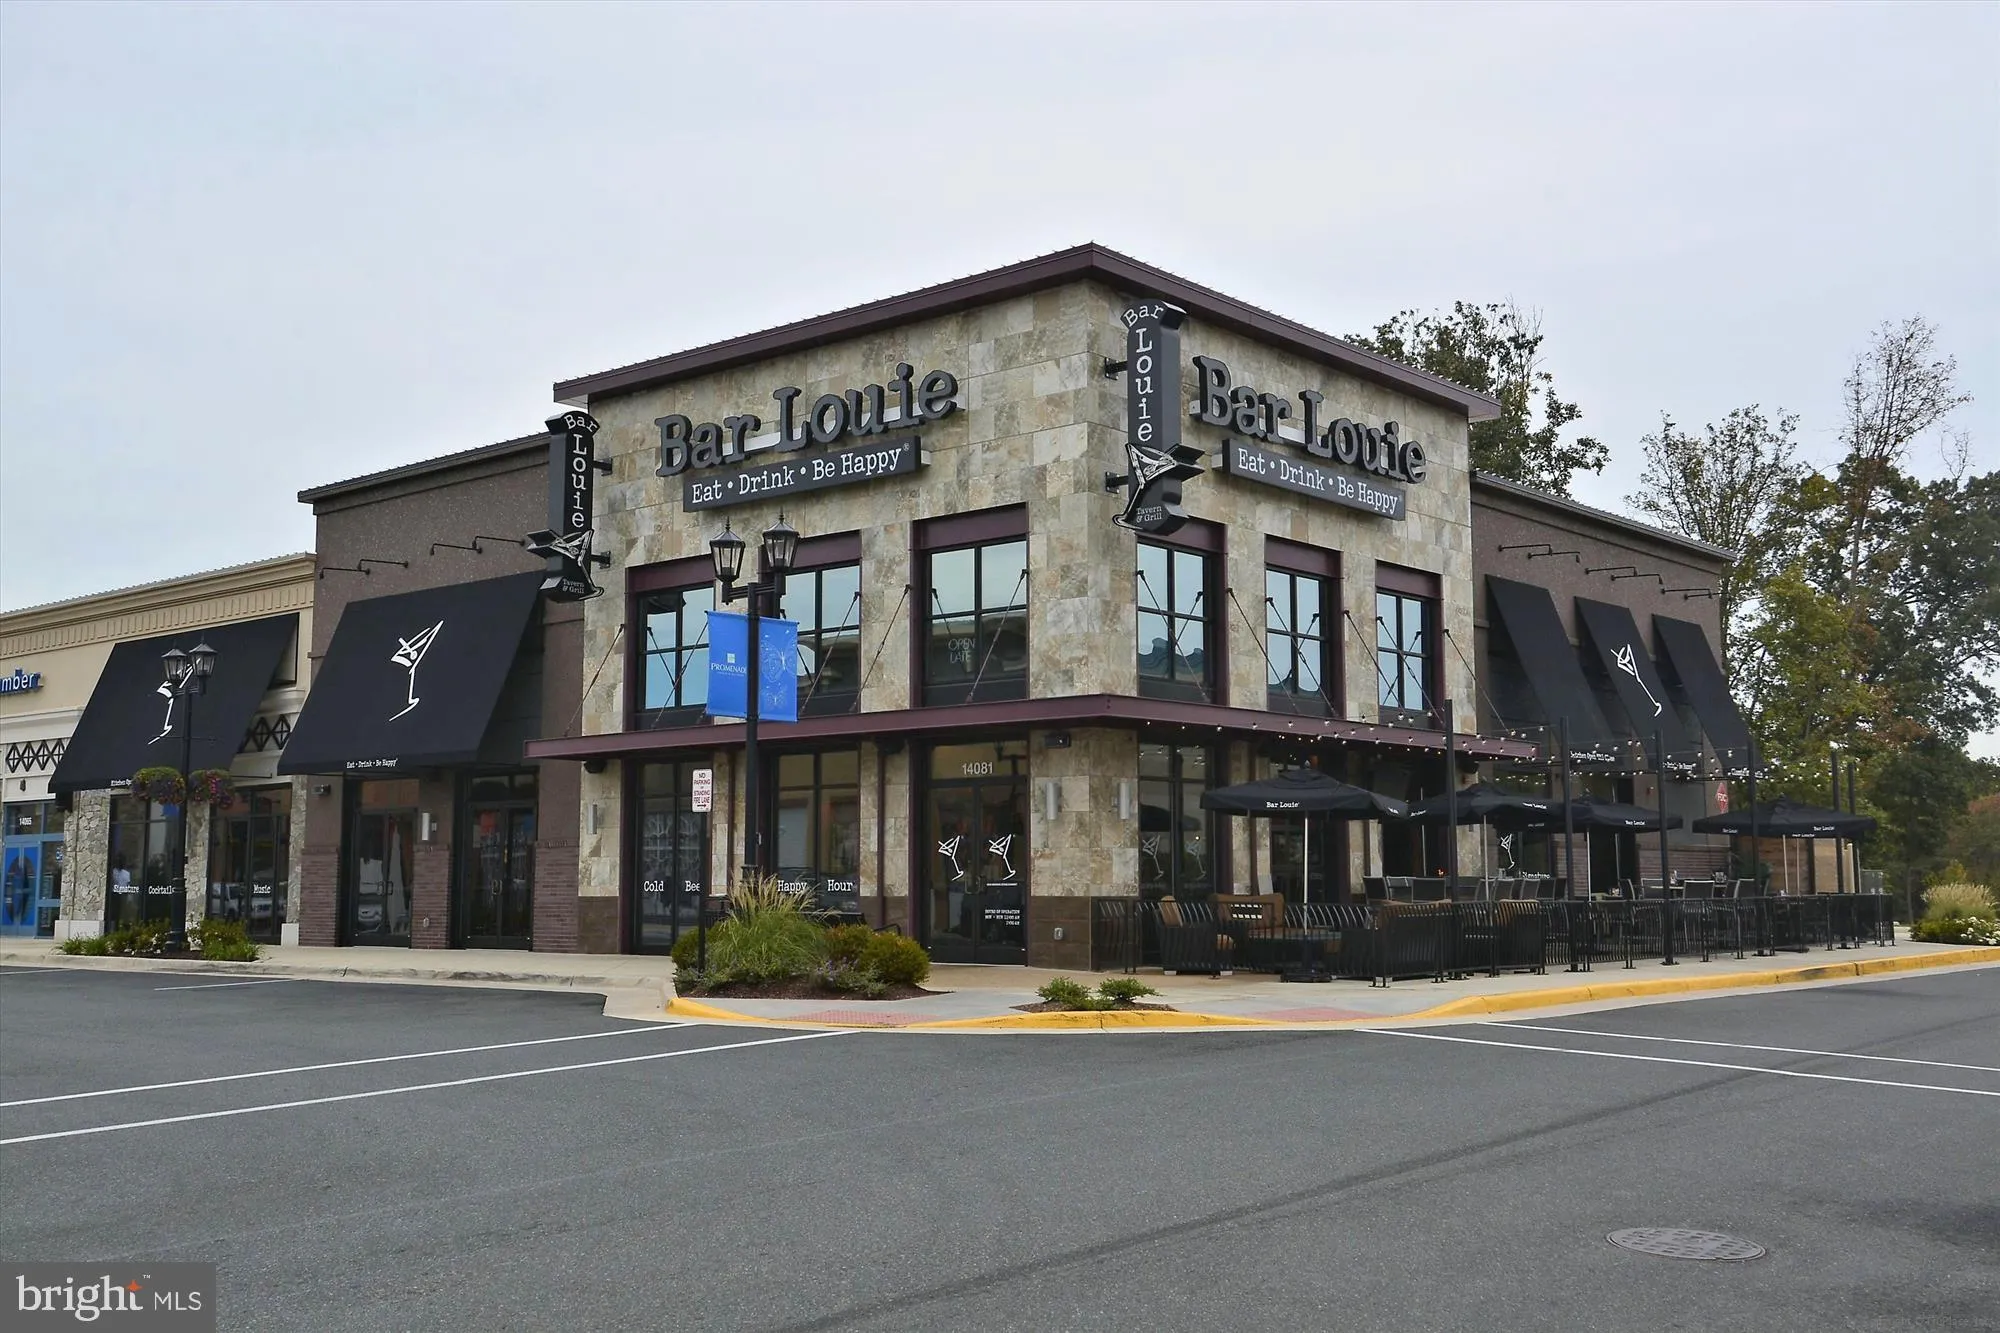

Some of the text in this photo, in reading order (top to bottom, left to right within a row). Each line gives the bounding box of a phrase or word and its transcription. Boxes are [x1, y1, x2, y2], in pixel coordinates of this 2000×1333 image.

[1124, 305, 1164, 326] Bar
[1135, 328, 1153, 442] Louie
[564, 414, 598, 433] Bar
[655, 363, 959, 477] Bar Louie
[1193, 355, 1427, 484] Bar Louie
[571, 433, 588, 528] Louie
[691, 480, 722, 504] Eat
[738, 465, 794, 495] Drink
[811, 457, 836, 481] Be
[1238, 447, 1266, 475] Eat
[1279, 459, 1325, 491] Drink
[1337, 476, 1355, 499] Be
[1136, 506, 1162, 515] Tavern
[1144, 512, 1162, 521] Grill
[948, 638, 975, 650] OPEN
[950, 651, 971, 664] LATE
[962, 761, 993, 775] 14081
[253, 884, 272, 894] Music
[643, 880, 700, 892] Cold Bee
[777, 879, 854, 894] Happy Hour
